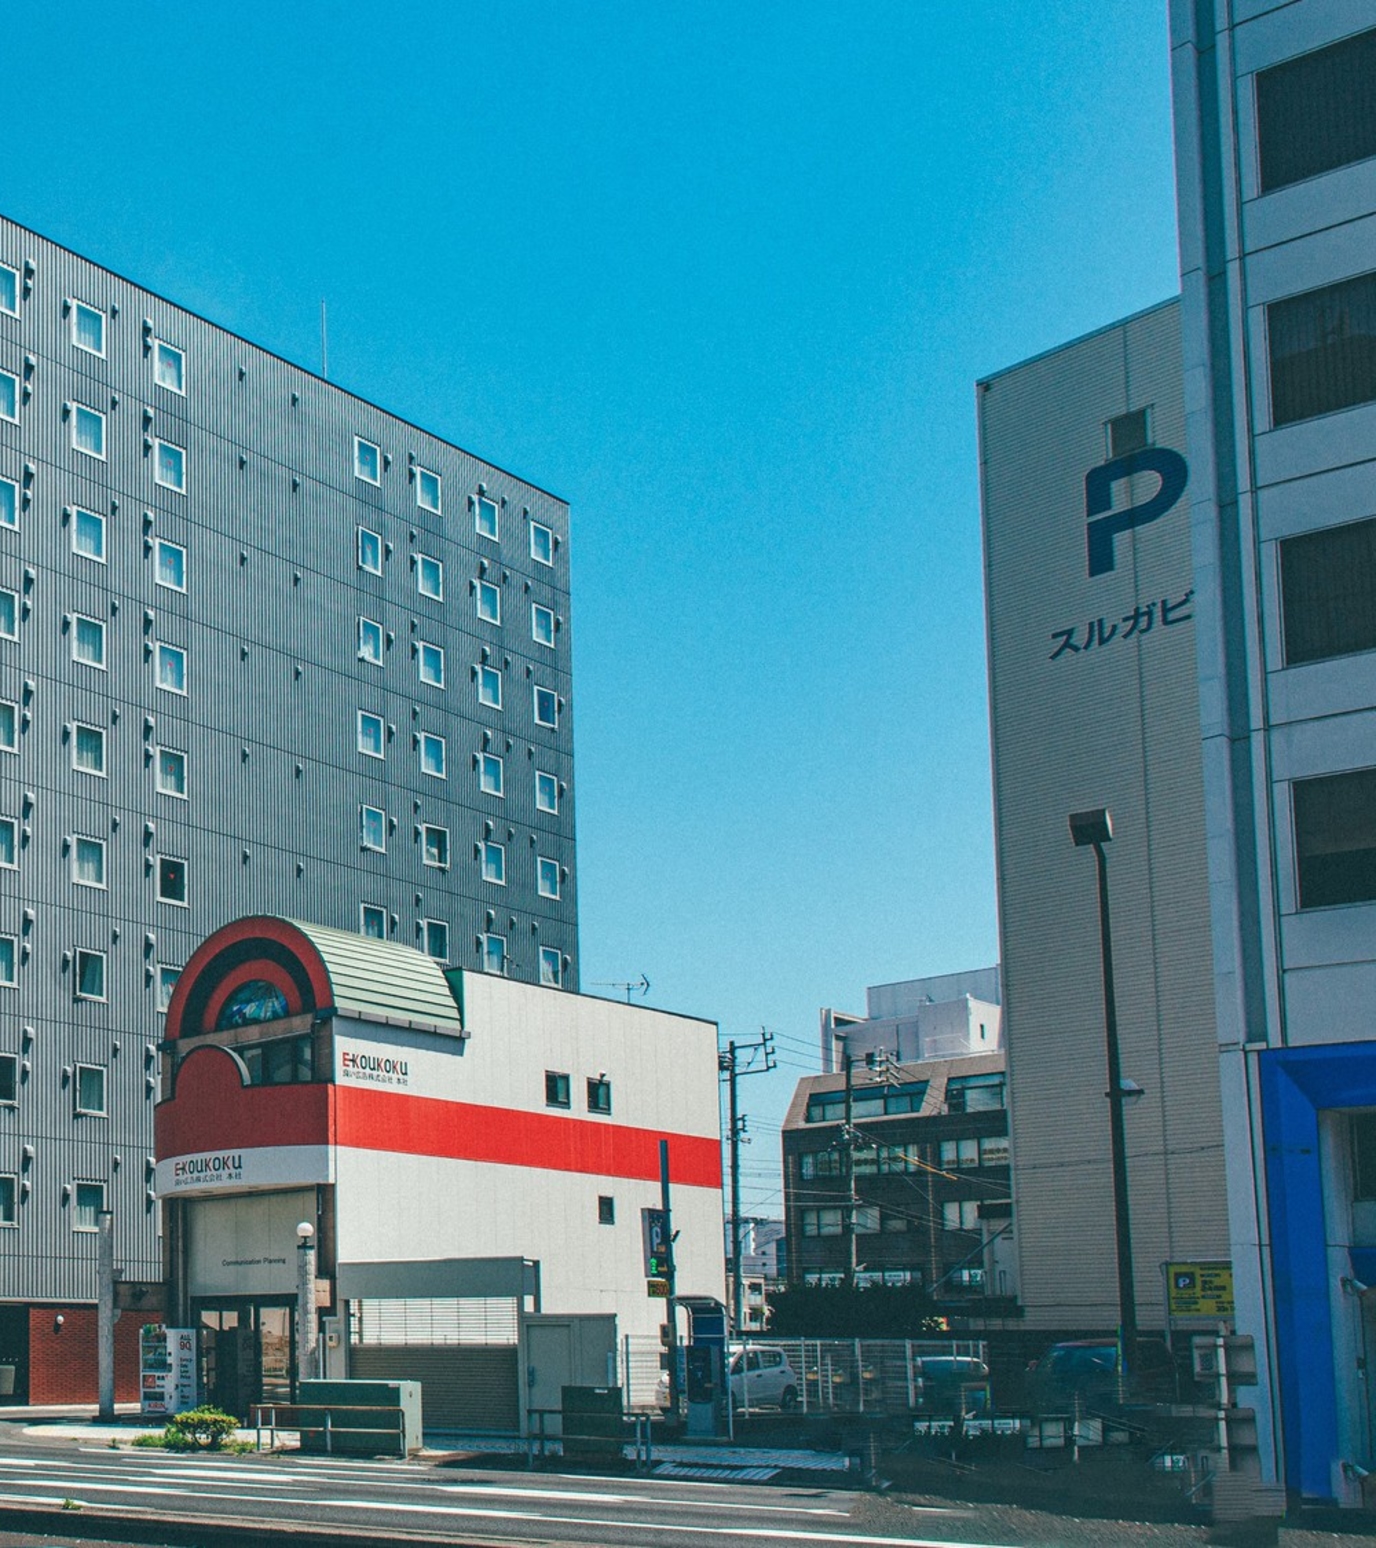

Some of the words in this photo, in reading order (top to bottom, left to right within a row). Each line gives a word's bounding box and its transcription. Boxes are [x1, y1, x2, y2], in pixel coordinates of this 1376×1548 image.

[1084, 446, 1188, 578] P
[1048, 589, 1195, 660] スルガビ
[396, 1078, 408, 1086] 本社
[226, 1172, 242, 1181] 本社
[221, 1258, 262, 1267] Communication
[262, 1257, 286, 1265] Planning
